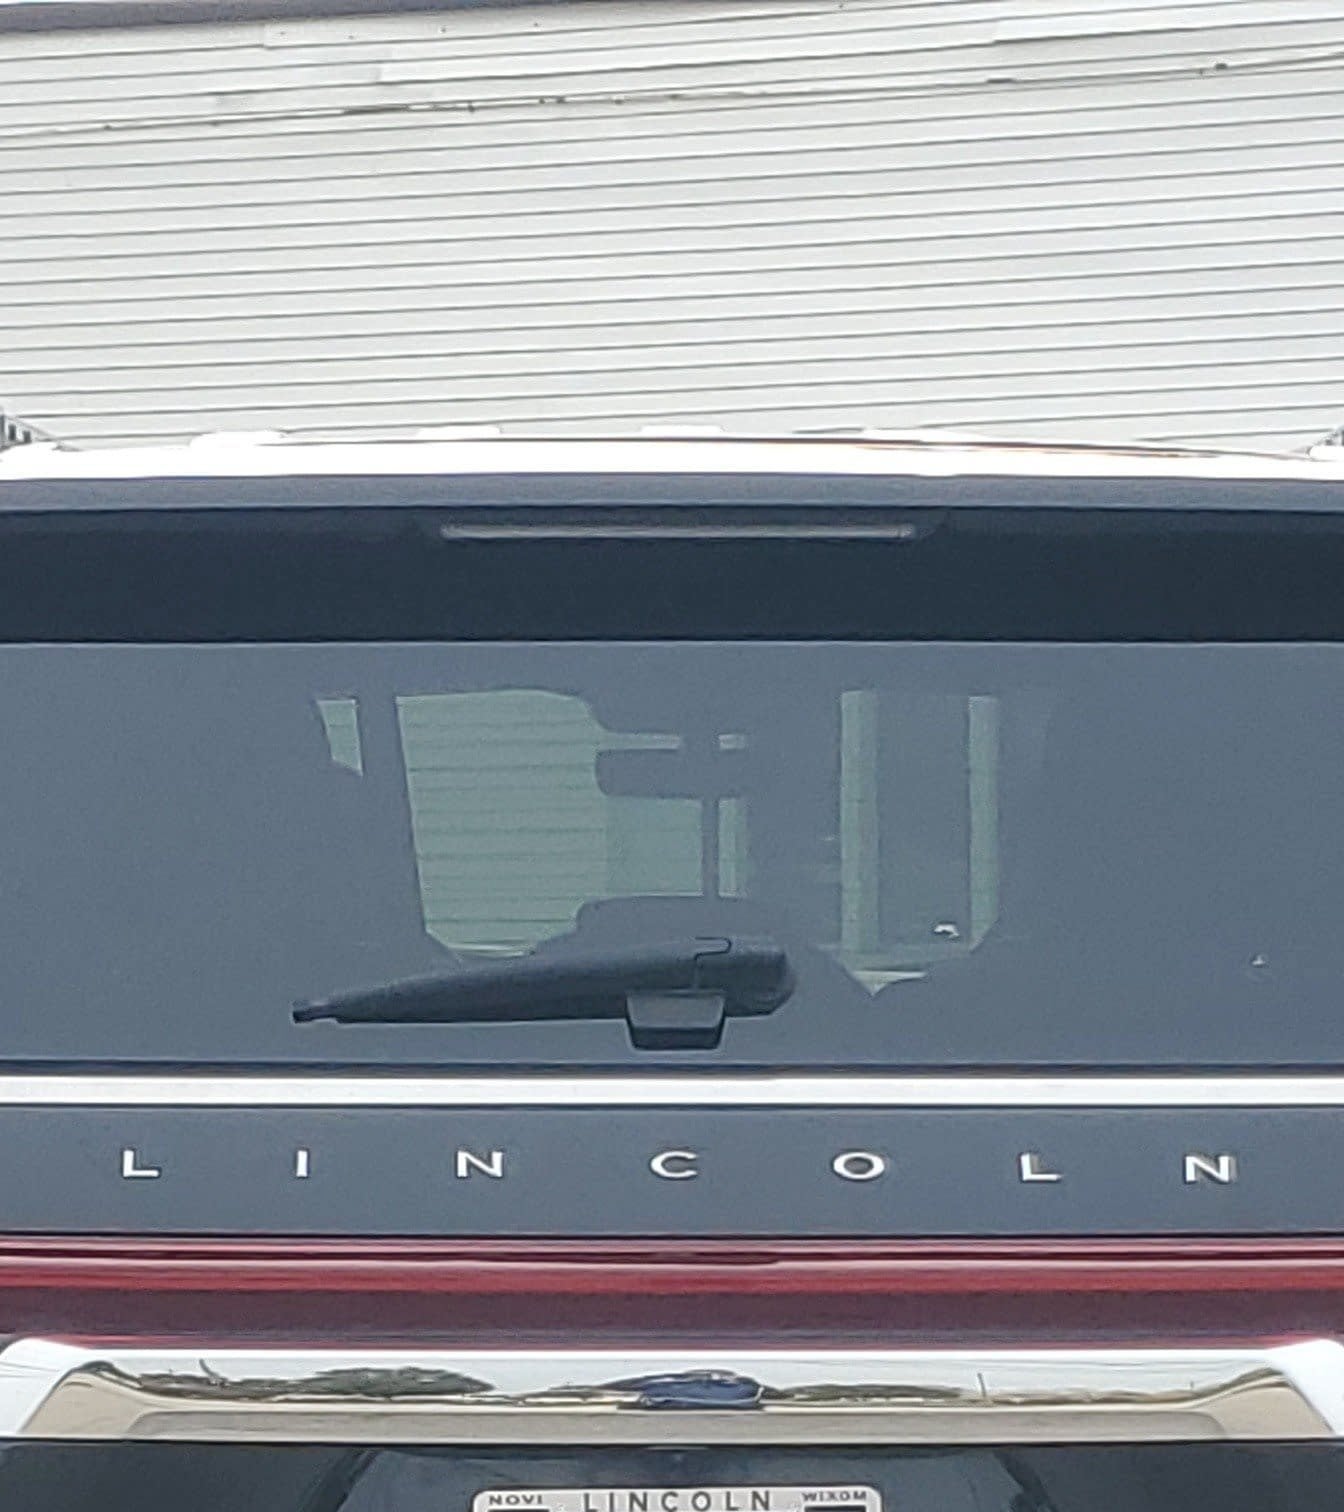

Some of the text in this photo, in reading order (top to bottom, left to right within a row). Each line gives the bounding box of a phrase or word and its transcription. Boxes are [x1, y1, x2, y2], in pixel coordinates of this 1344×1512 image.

[122, 1149, 1232, 1183] LINCOLN
[488, 1490, 867, 1512] NOVI LINCOLN WIXOM
